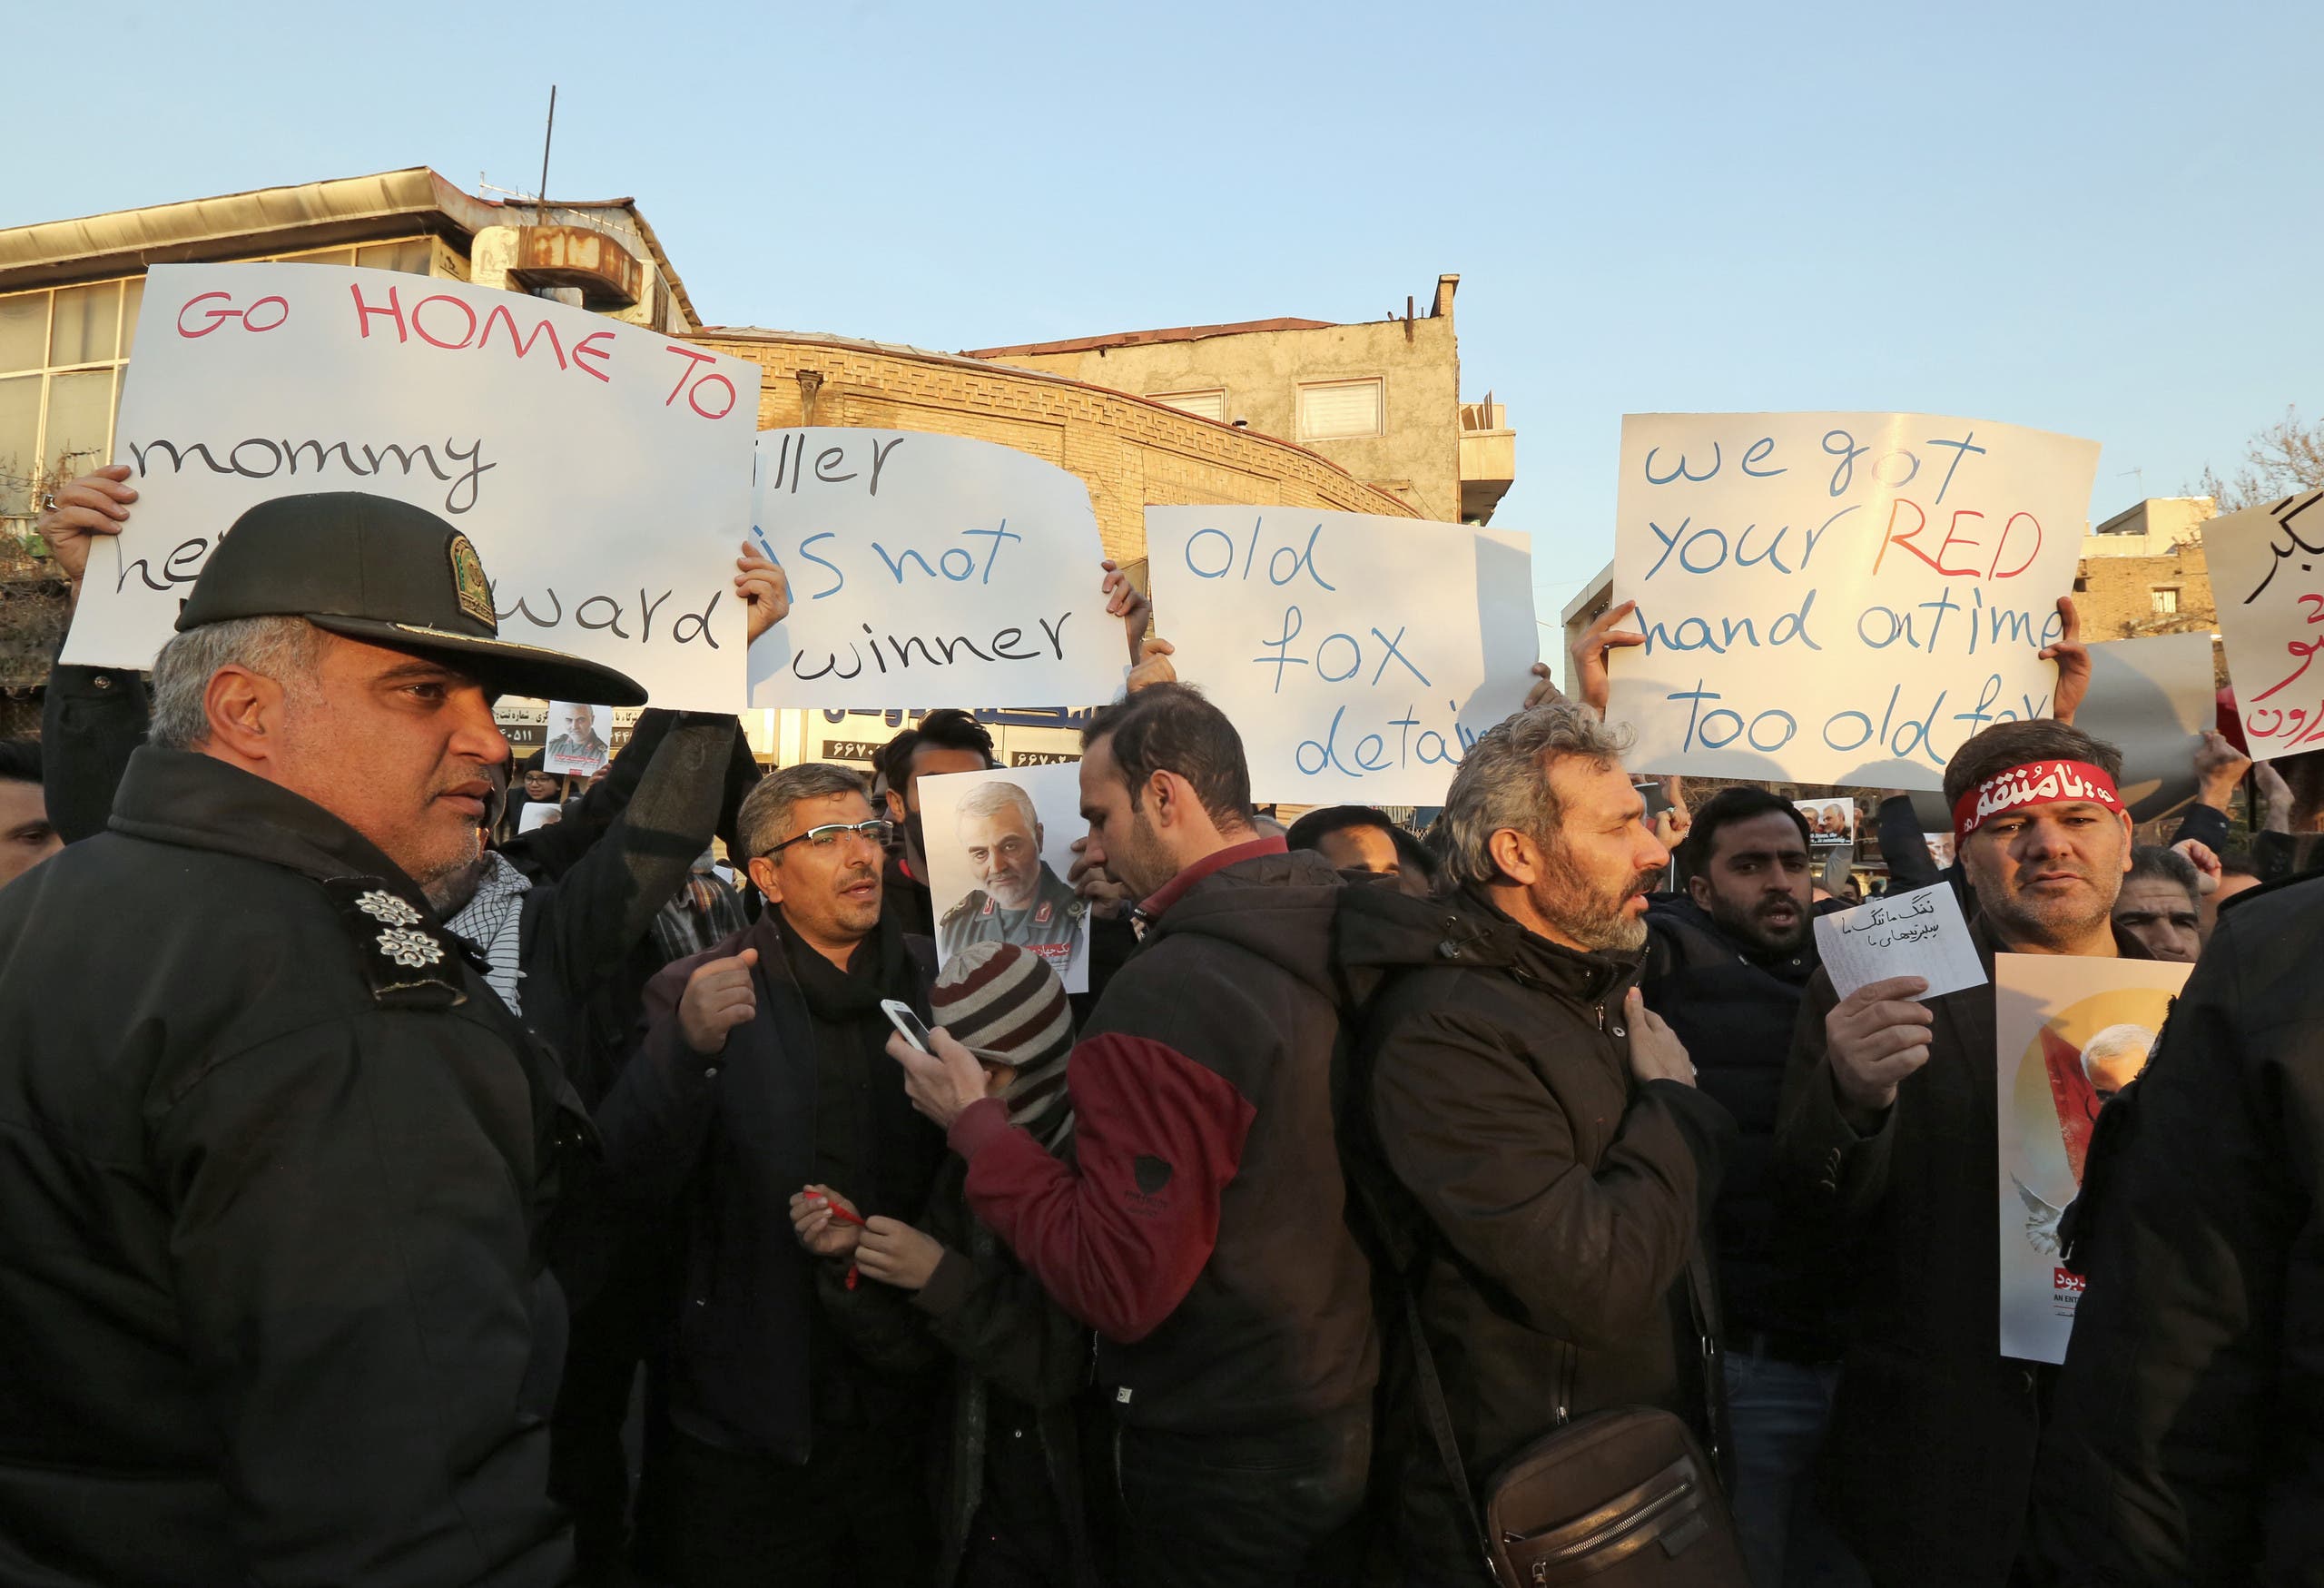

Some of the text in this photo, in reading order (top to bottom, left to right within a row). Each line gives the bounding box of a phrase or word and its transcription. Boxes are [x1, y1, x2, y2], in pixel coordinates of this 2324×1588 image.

[177, 283, 736, 419] GO HOME TO
[130, 437, 497, 515] mommy
[1645, 429, 1986, 505] we got
[872, 518, 1021, 584] not
[1644, 498, 2042, 581] your RED
[490, 578, 722, 649] ward
[793, 611, 1072, 680] winner
[1253, 606, 1431, 694] fox
[1634, 588, 1822, 656] hand
[833, 742, 881, 757] ۶۶۷۰
[1823, 684, 1946, 765] old
[2064, 1296, 2078, 1304] ENT
